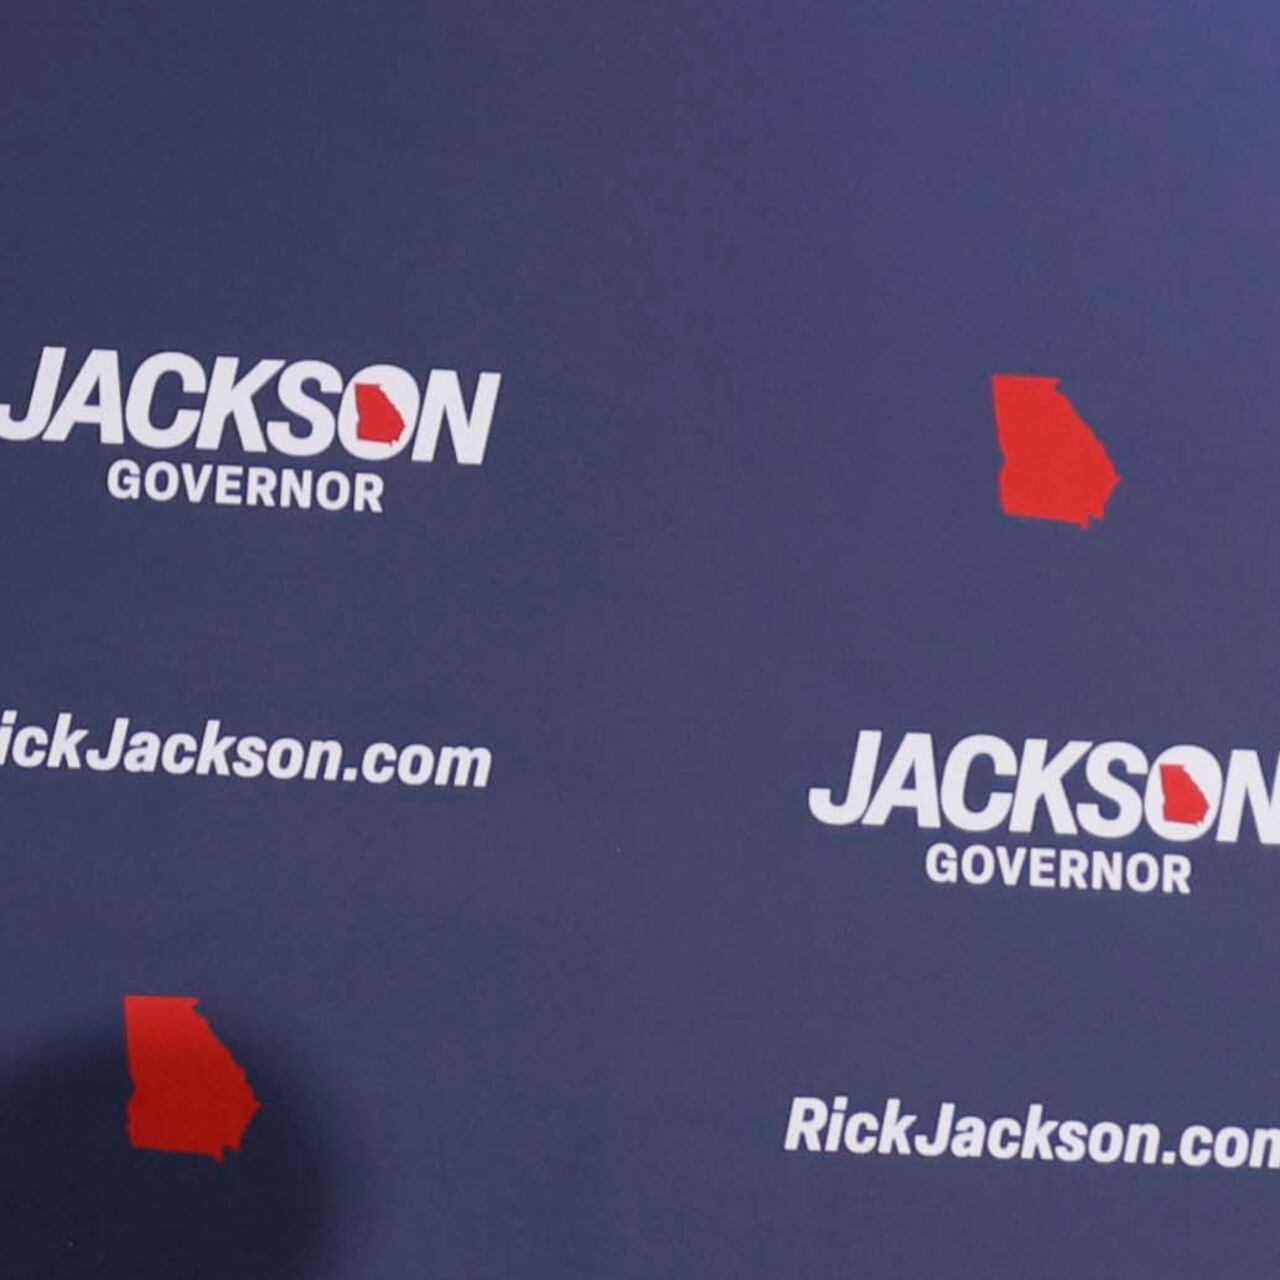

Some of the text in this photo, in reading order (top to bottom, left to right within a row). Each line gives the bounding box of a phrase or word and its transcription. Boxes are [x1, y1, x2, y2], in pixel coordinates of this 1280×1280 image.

[0, 346, 502, 466] JACKSON
[107, 459, 384, 513] GOVERNOR
[925, 842, 1192, 894] GOVERNOR
